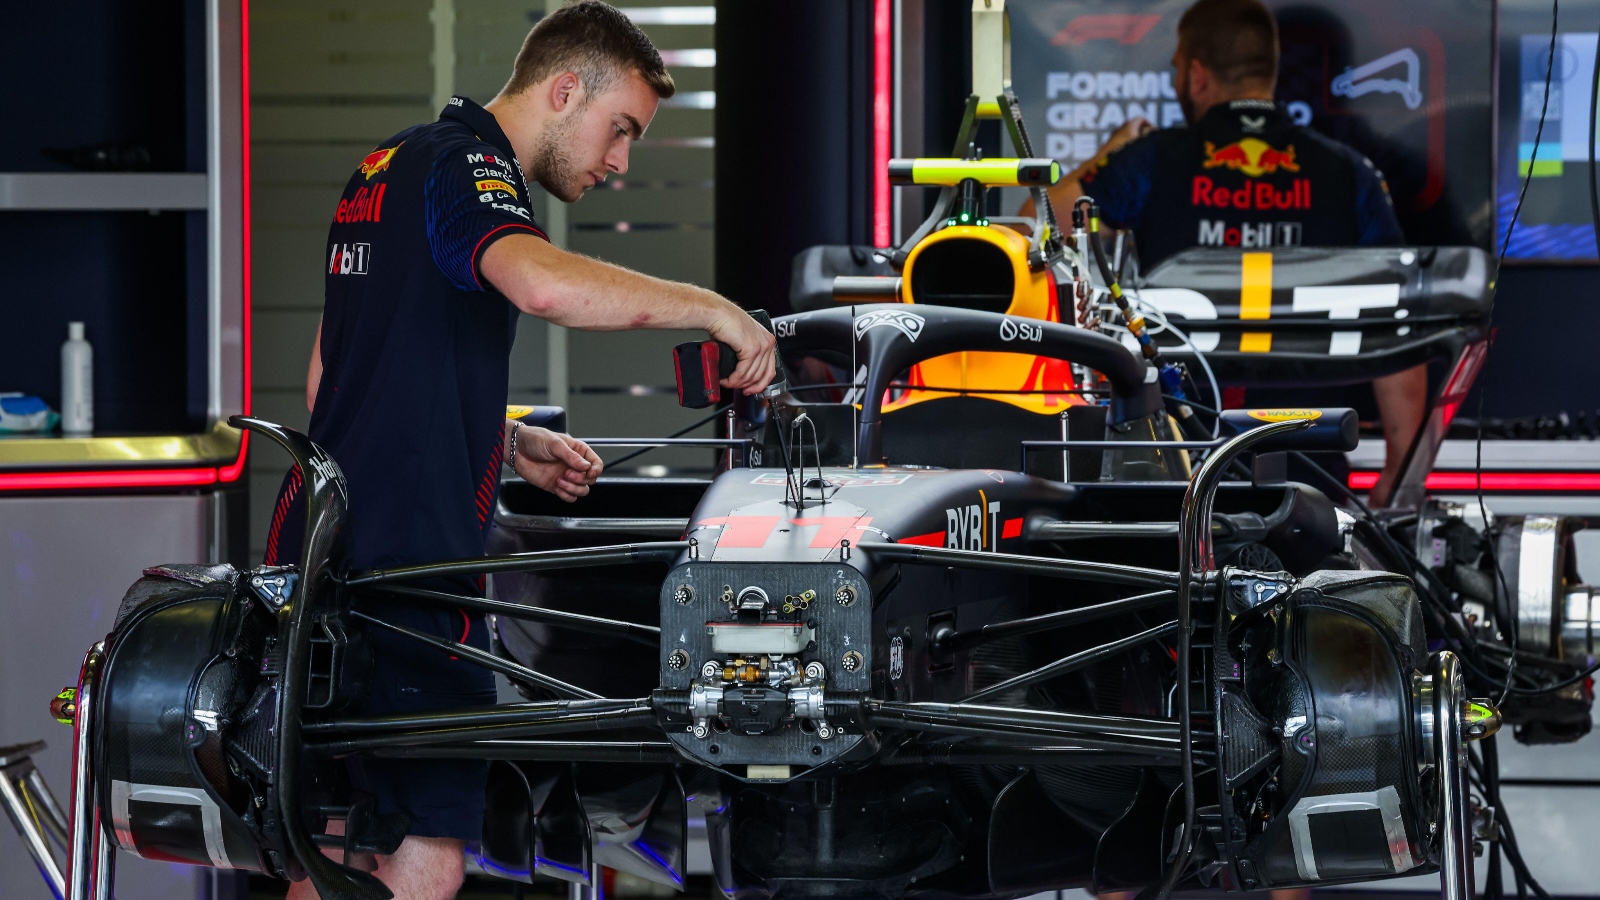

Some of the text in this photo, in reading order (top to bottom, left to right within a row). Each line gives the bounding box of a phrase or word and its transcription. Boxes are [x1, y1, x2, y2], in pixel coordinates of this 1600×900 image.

[1047, 72, 1177, 99] FORMU
[1198, 219, 1273, 247] Mobil
[777, 318, 798, 338] Sui
[855, 311, 921, 336] OXXO
[1019, 322, 1043, 342] Sui
